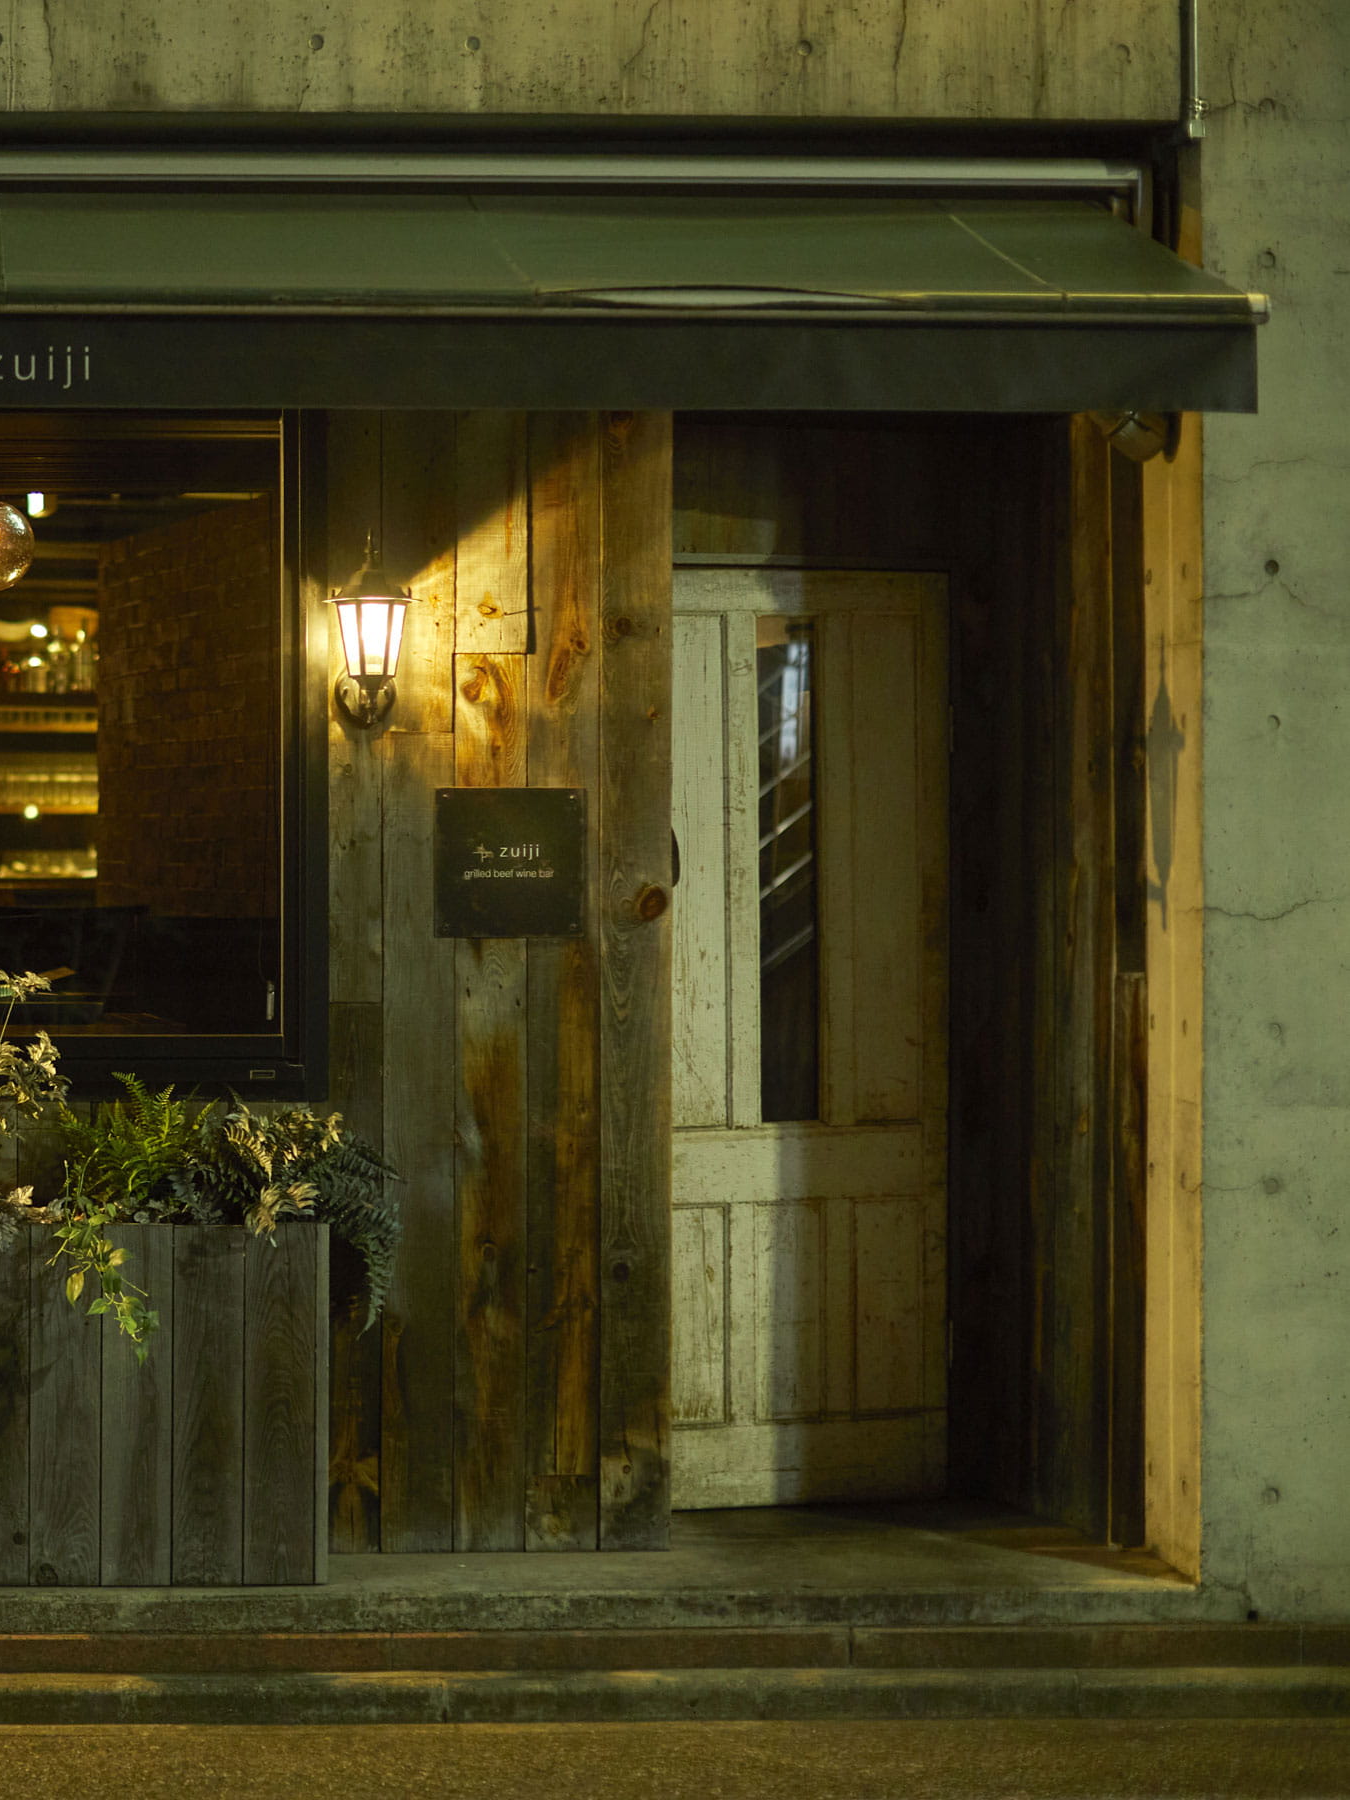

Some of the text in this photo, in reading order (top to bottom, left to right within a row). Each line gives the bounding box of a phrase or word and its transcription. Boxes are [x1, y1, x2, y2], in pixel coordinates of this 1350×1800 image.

[499, 844, 540, 861] zuiji
[464, 868, 554, 880] grilled beef wine bar
